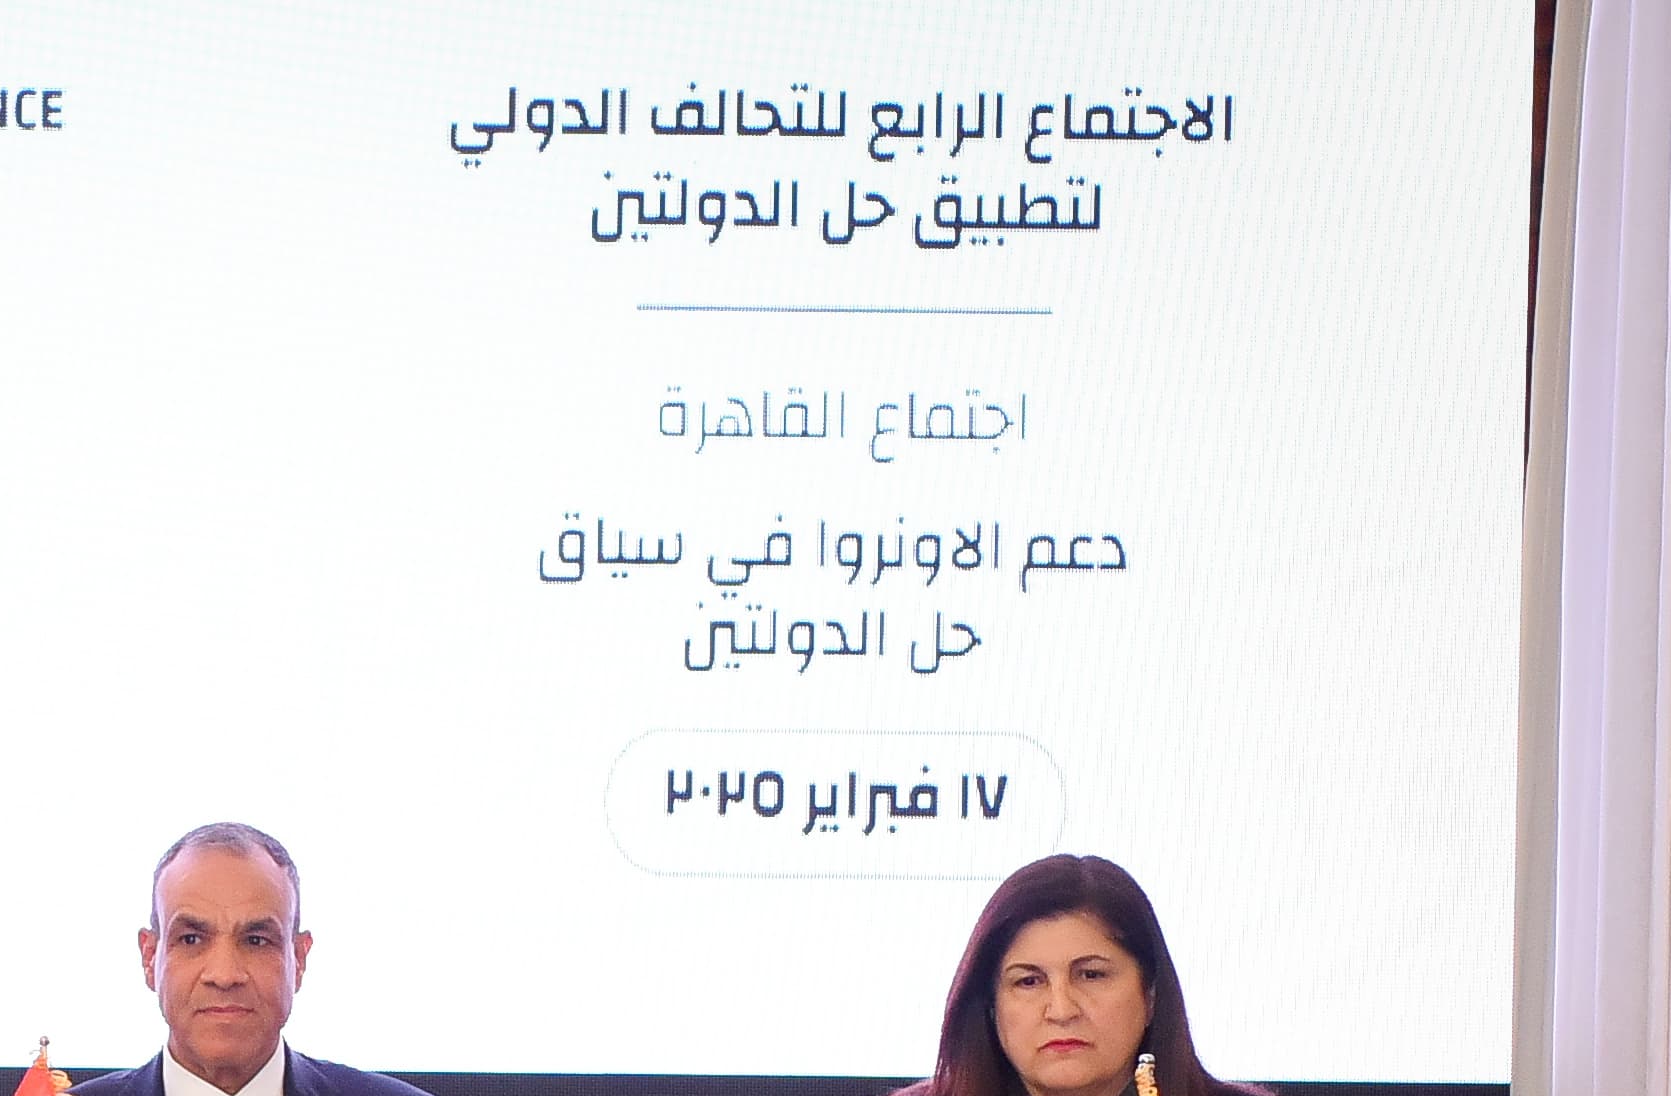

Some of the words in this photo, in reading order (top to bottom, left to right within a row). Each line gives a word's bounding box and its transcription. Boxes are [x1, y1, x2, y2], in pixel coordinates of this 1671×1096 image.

[451, 87, 627, 168] الدولي
[651, 82, 846, 137] للتحالف
[868, 92, 1003, 162] الرابع
[1024, 87, 1232, 164] الاجتماع
[592, 171, 798, 244] الدولتين
[823, 181, 895, 245] حل
[912, 176, 1101, 249] لتطبيق
[660, 386, 844, 454] القاهرة
[869, 388, 1026, 464] اجتماع
[540, 513, 682, 584] سياق
[707, 515, 791, 600] في
[820, 514, 999, 587] الاونروا
[1019, 530, 1127, 593] دعم
[685, 602, 884, 674] الدولتين
[911, 609, 982, 676] حل
[802, 766, 938, 836] فبراير
